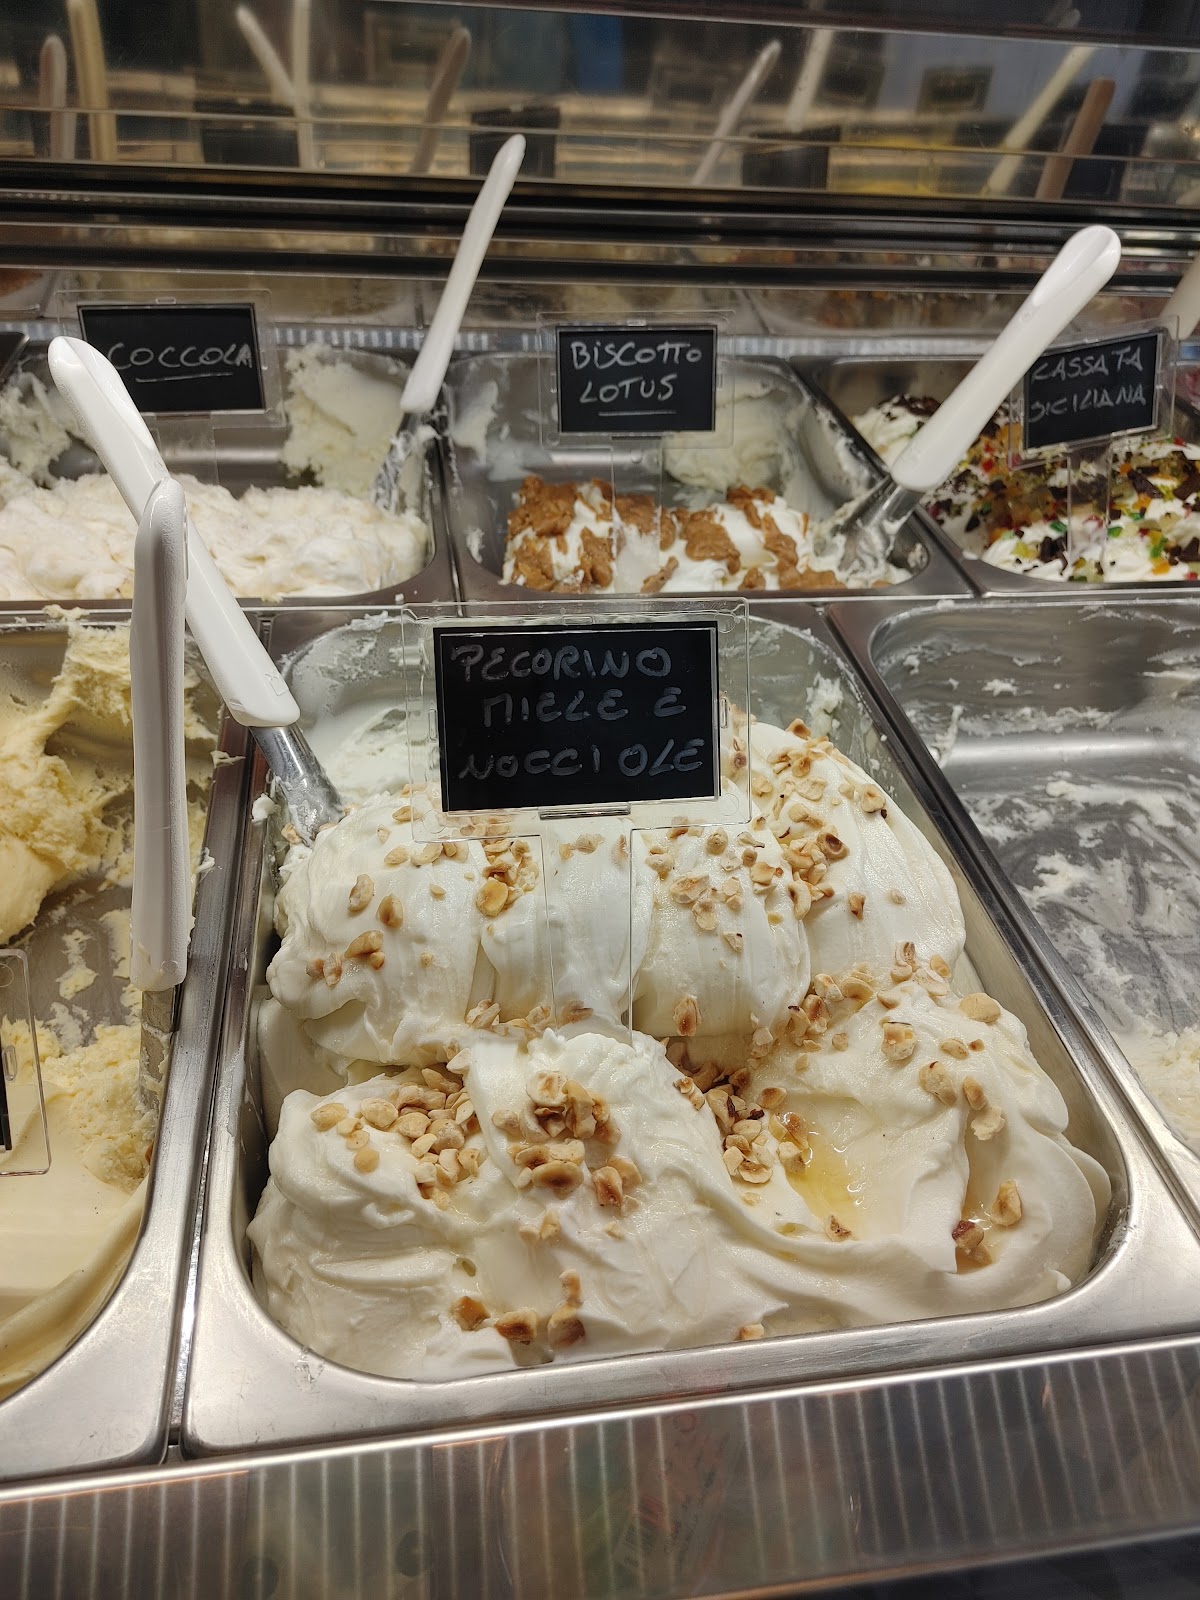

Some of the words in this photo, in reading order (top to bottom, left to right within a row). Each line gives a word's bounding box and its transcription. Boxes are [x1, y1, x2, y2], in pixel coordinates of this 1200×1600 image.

[107, 342, 252, 370] COCCOLA
[579, 373, 678, 403] LOTUS
[1028, 384, 1147, 423] SICILIANA
[450, 644, 672, 682] PECORINO
[483, 689, 628, 727] MIELE
[653, 686, 686, 718] E
[457, 738, 705, 780] NOCCIOLE
